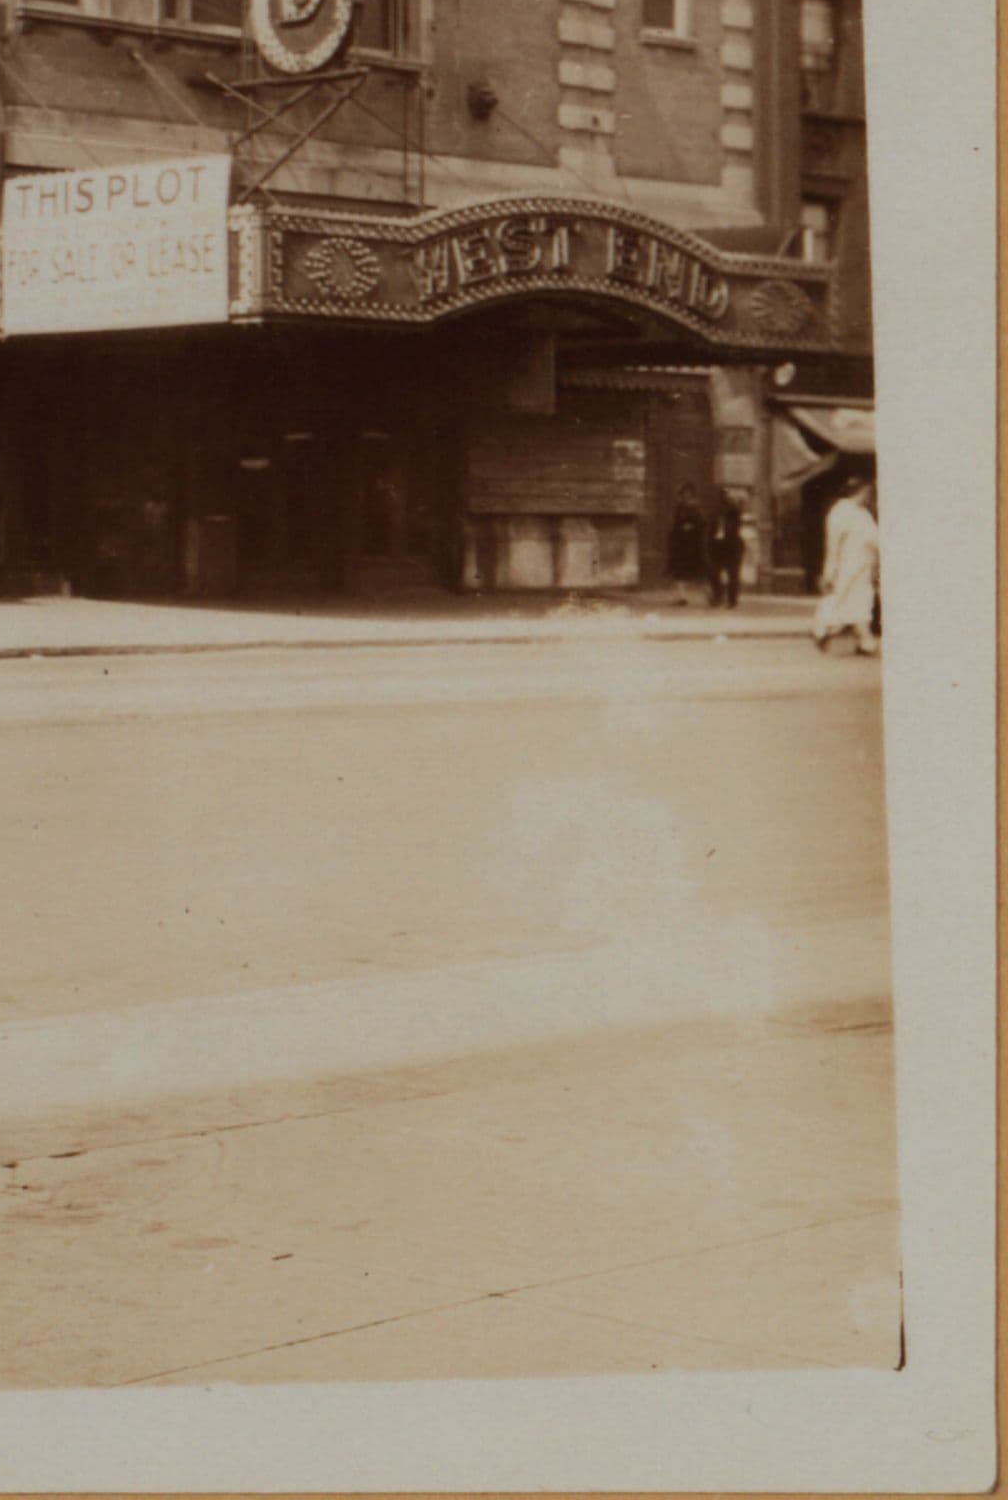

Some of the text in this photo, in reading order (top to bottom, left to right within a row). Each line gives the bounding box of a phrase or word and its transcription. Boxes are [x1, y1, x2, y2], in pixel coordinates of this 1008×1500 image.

[16, 165, 208, 220] THIS PLOT
[413, 216, 729, 319] WEST END
